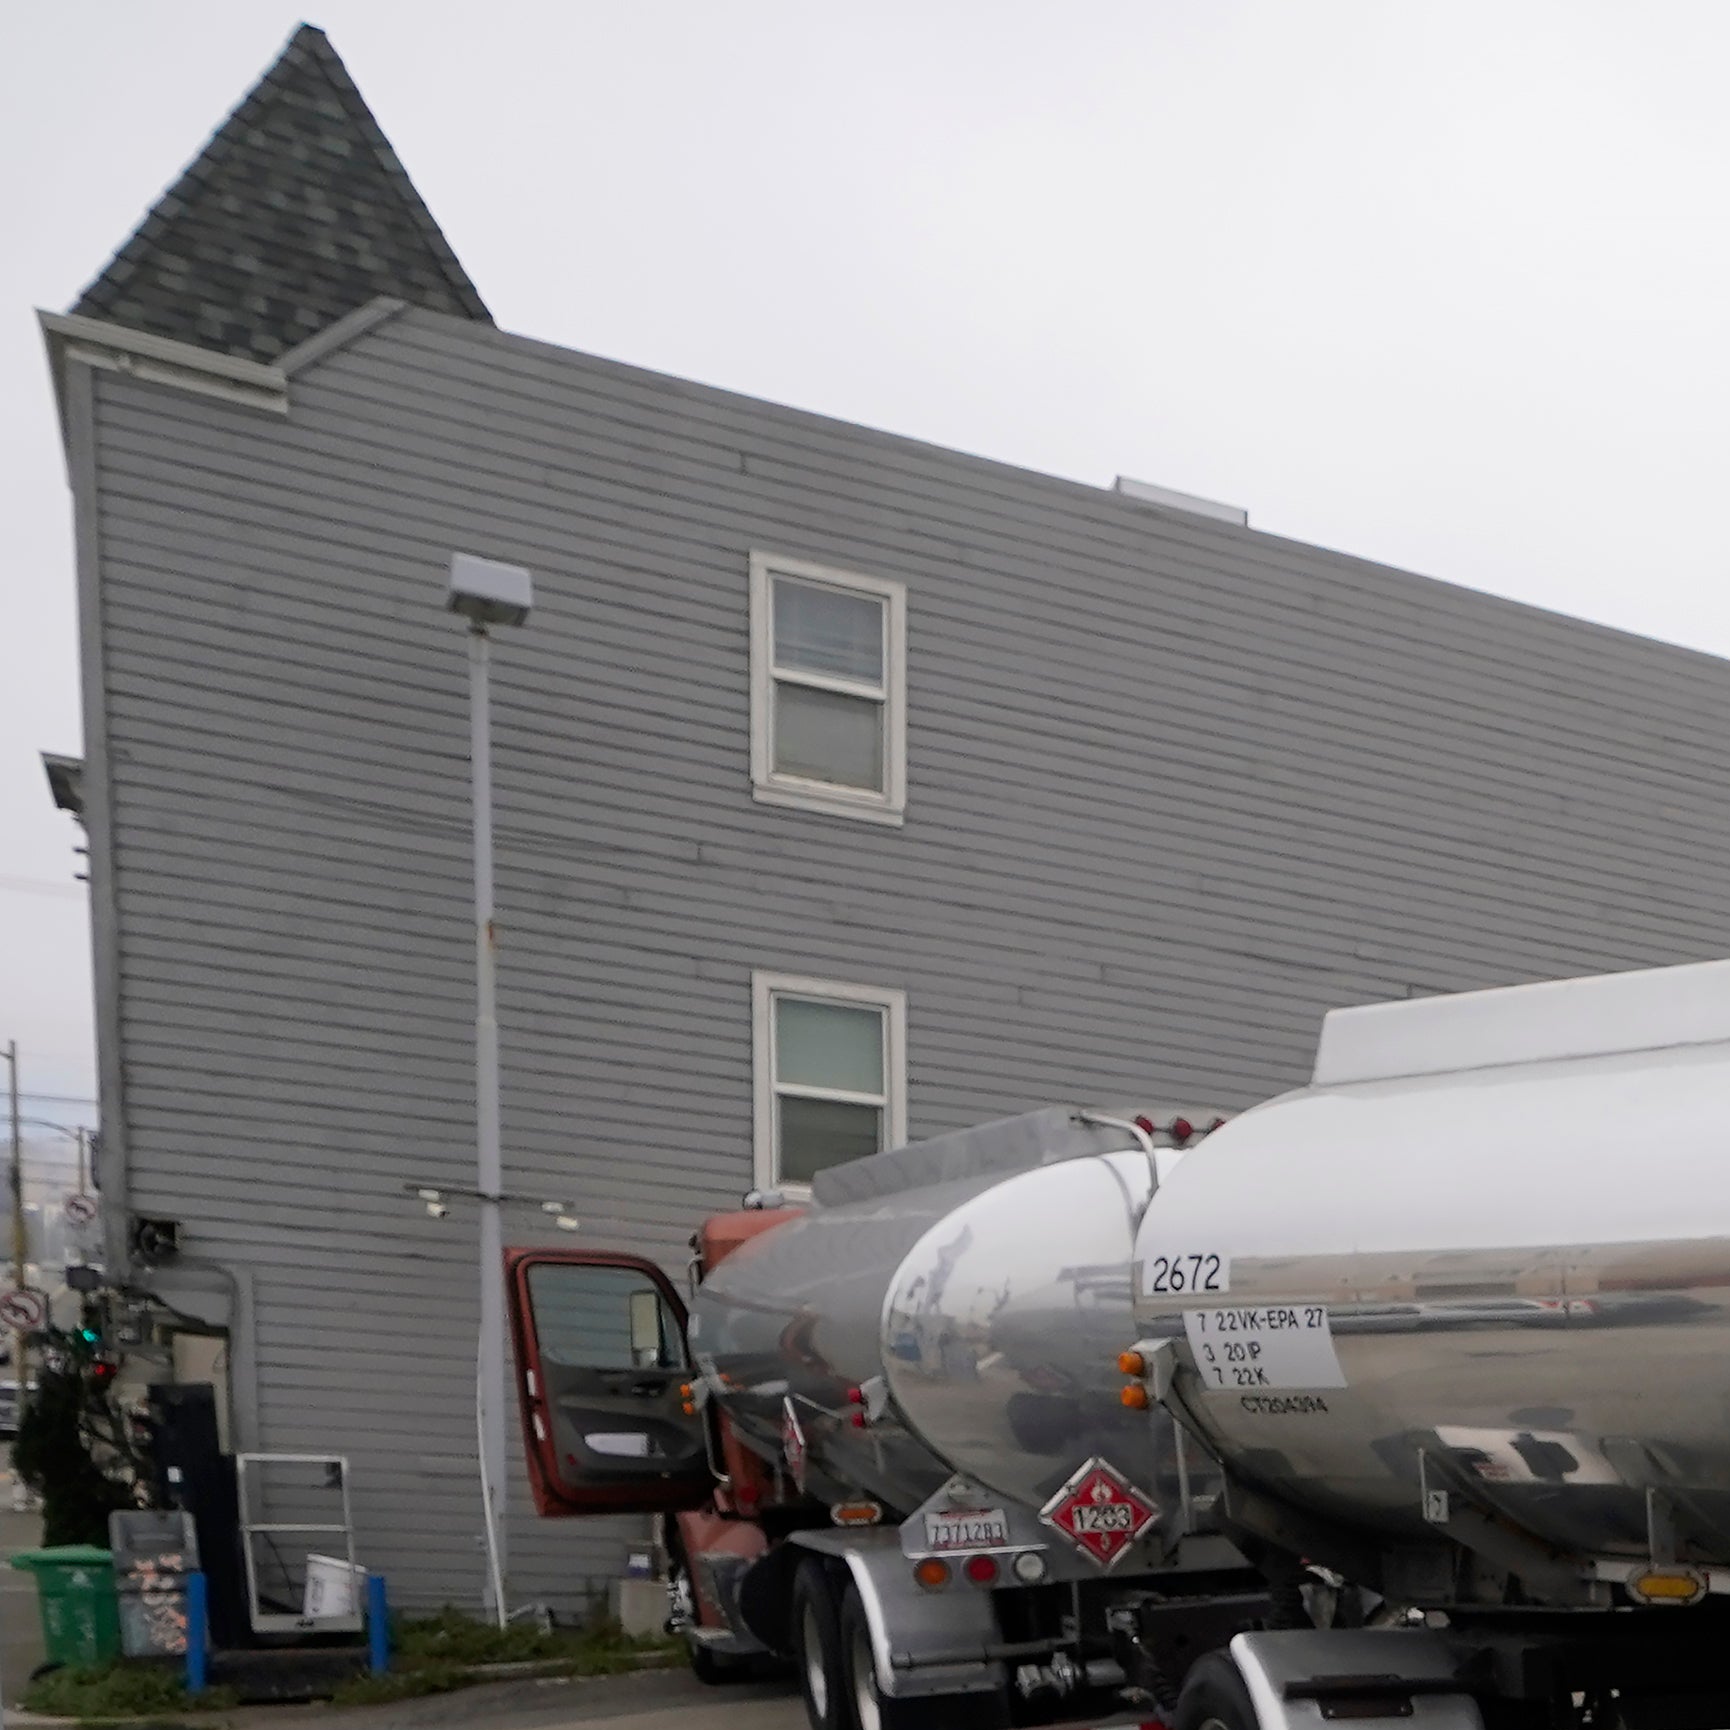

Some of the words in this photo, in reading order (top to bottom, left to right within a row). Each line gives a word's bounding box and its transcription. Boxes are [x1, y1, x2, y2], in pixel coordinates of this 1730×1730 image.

[1153, 1254, 1220, 1292] 2672
[1304, 1308, 1323, 1328] 27
[1232, 1367, 1270, 1385] 22K
[1073, 1505, 1131, 1529] 1203
